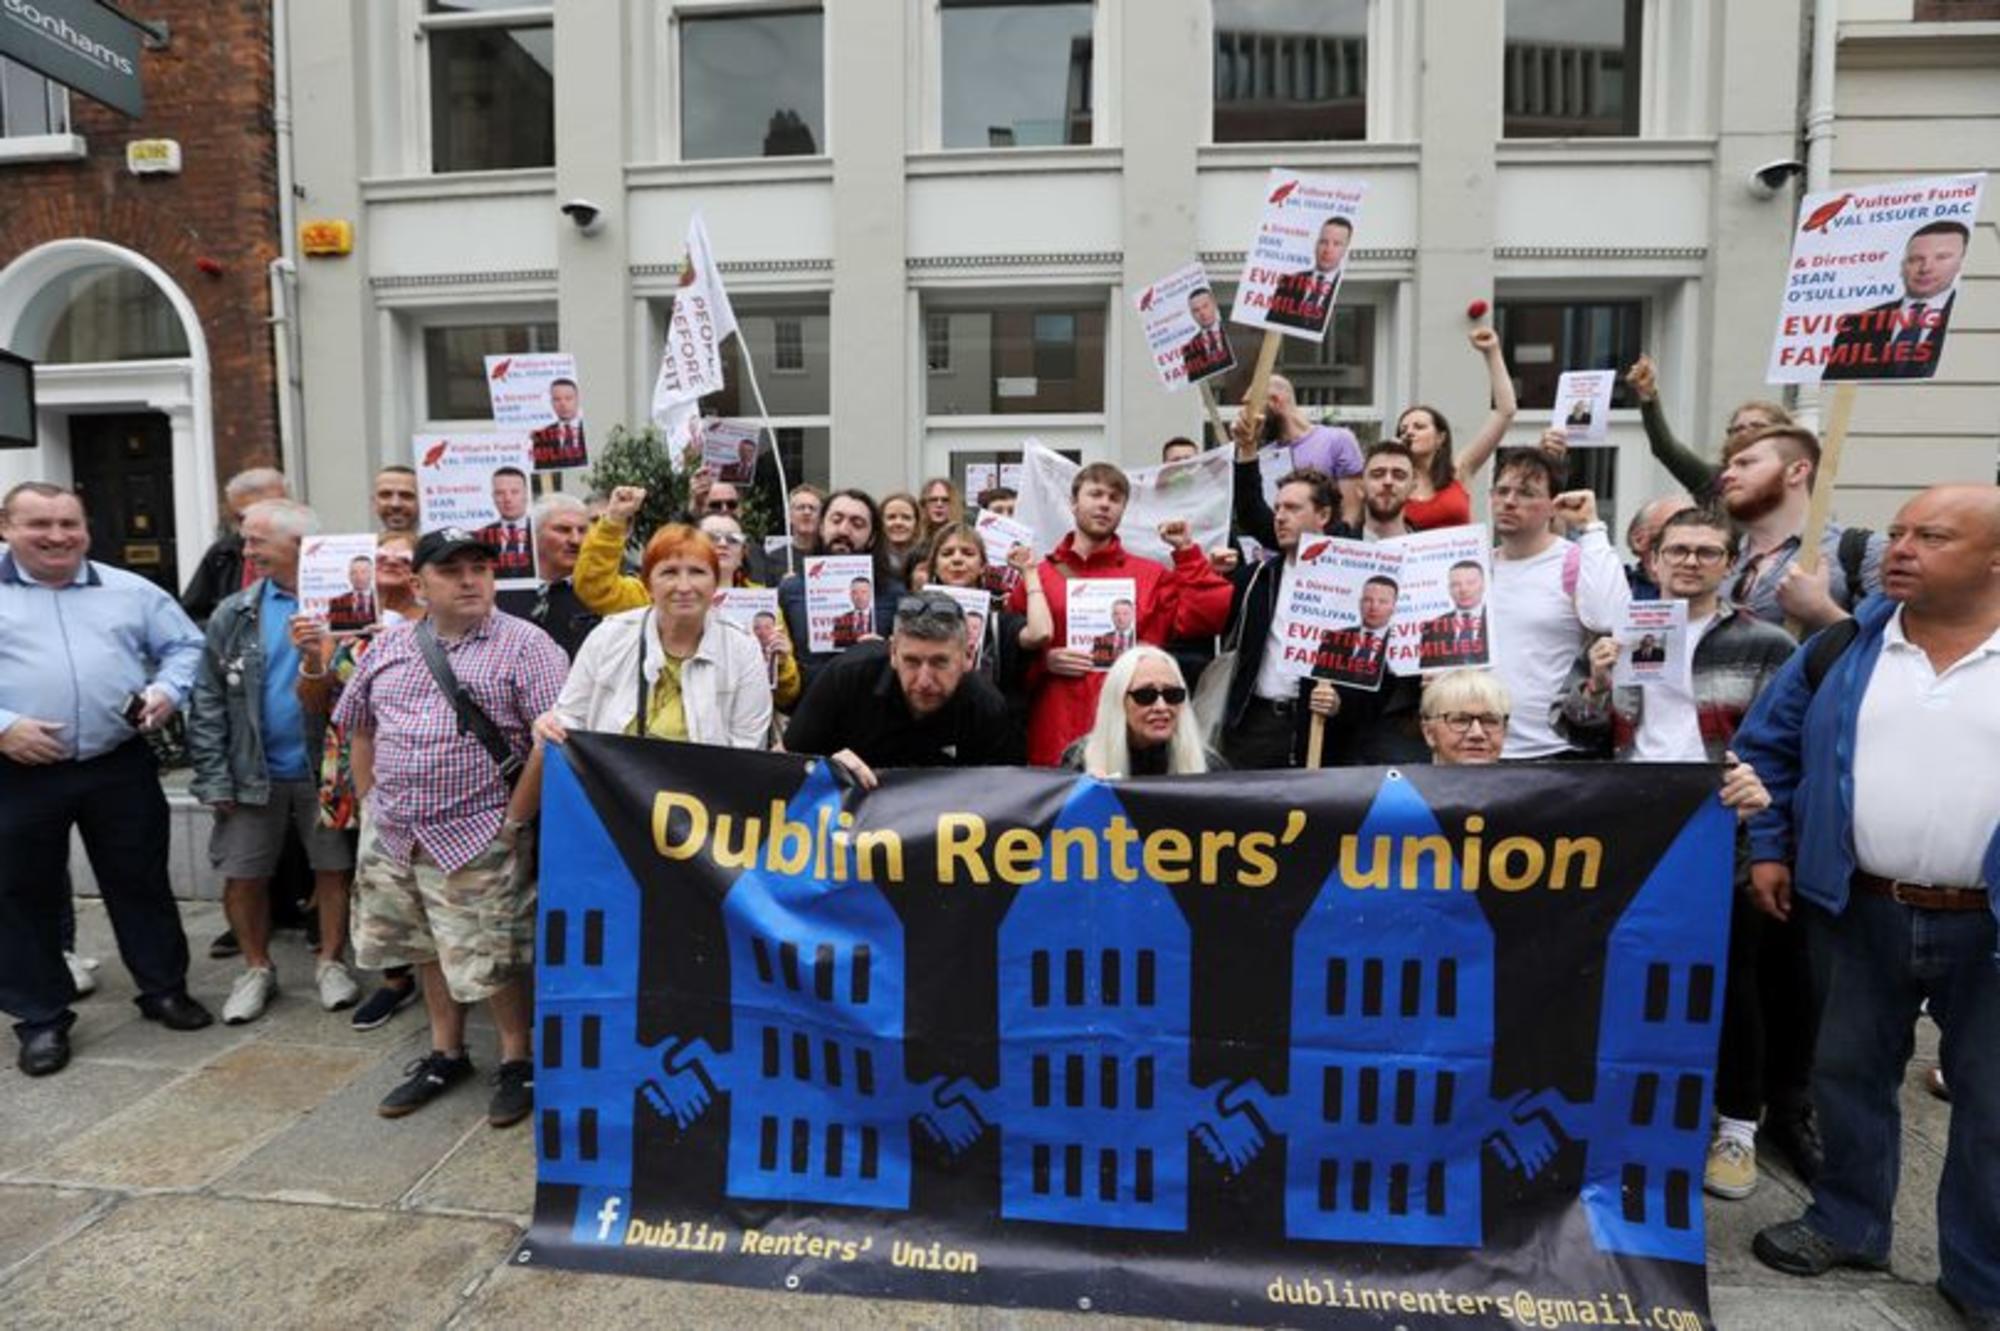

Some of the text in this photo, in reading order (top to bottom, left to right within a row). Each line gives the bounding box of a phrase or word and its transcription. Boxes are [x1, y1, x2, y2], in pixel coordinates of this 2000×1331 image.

[1853, 184, 1976, 209] Vulture Fund
[1832, 202, 1973, 228] VAL ISSUER DAC
[1794, 251, 1889, 269] & Director
[1790, 271, 1837, 286] SEAN
[1243, 290, 1325, 318] FAMILIES
[1788, 283, 1896, 302] O'SULLIVAN
[1783, 305, 1944, 336] EVICTING
[1779, 340, 1934, 366] FAMILIES
[1288, 622, 1384, 650] EVICTING
[1388, 638, 1484, 660] FAMILIES
[1284, 646, 1379, 673] FAMILIES
[651, 790, 1603, 891] Dublin Renters' union
[626, 1218, 727, 1253] Dublin
[740, 1229, 872, 1262] Renters'
[891, 1241, 979, 1273] Union
[1267, 1277, 1703, 1331] dublinrenters@gmail.com
